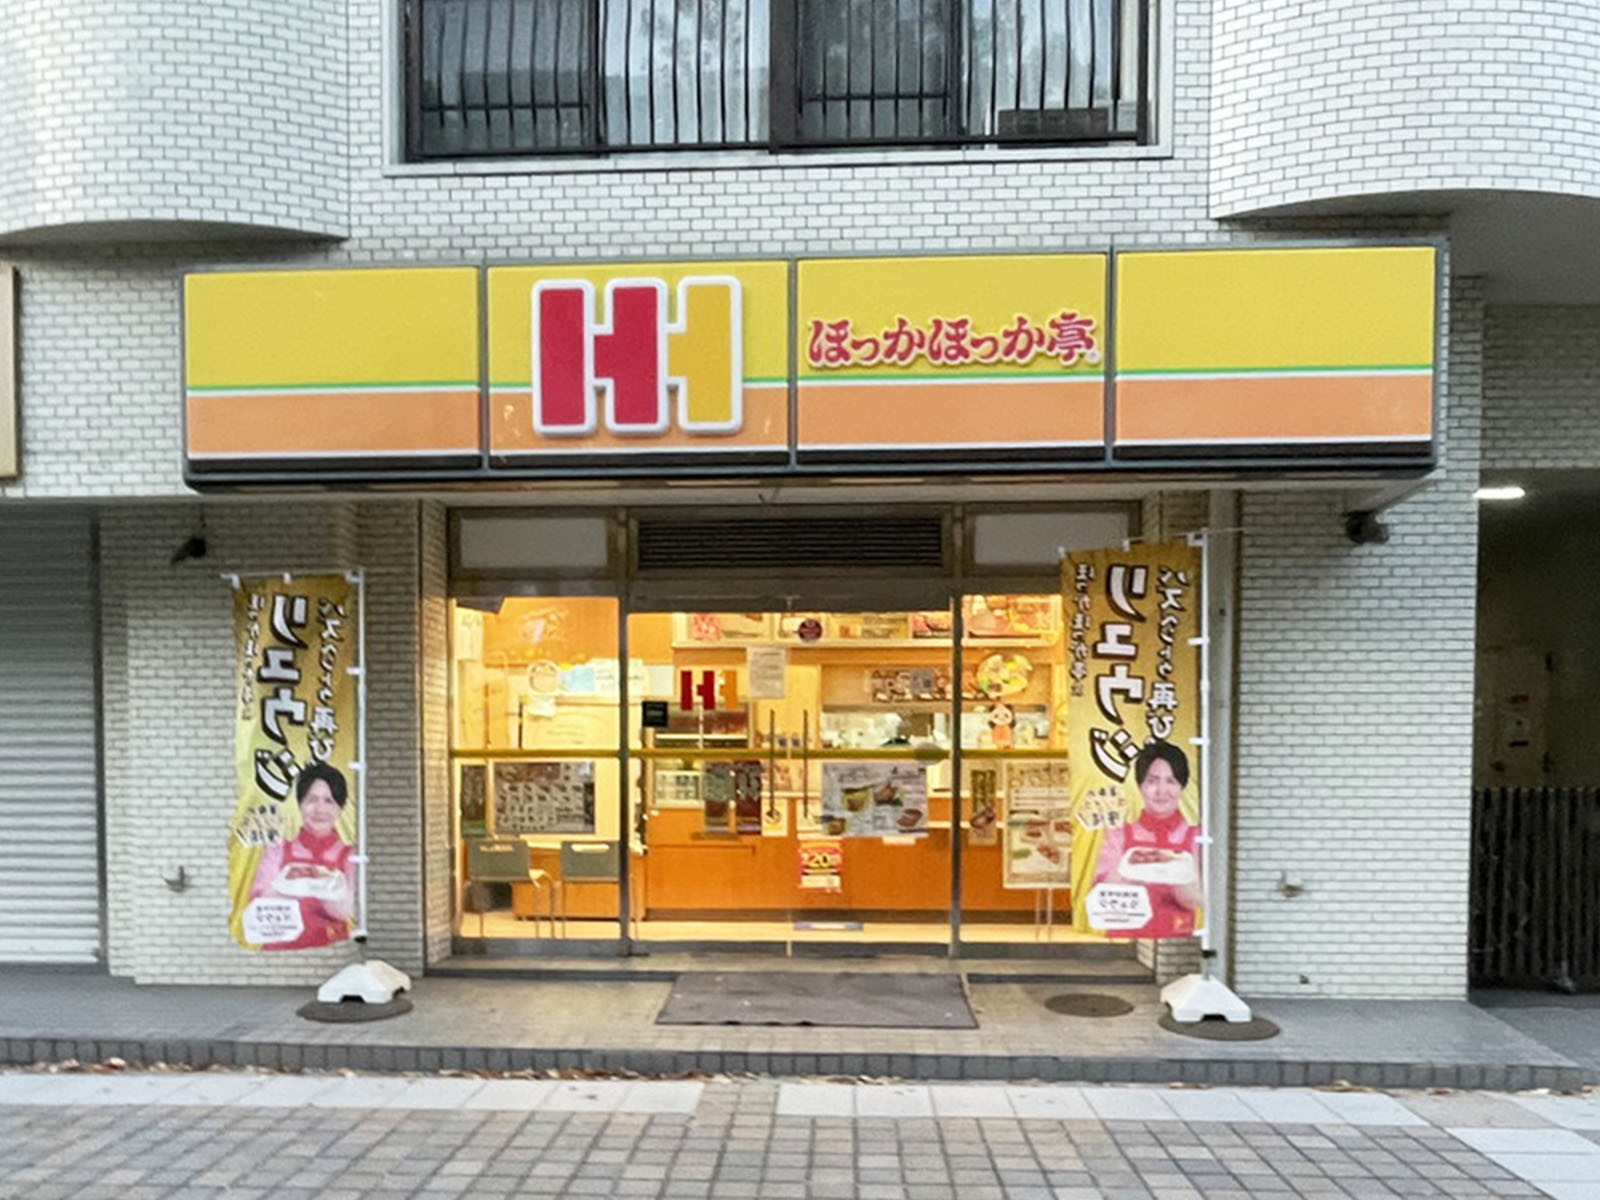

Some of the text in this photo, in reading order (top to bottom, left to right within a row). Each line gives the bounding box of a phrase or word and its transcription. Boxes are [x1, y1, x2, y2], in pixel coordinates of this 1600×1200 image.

[807, 311, 1096, 363] ほっかほっか亭
